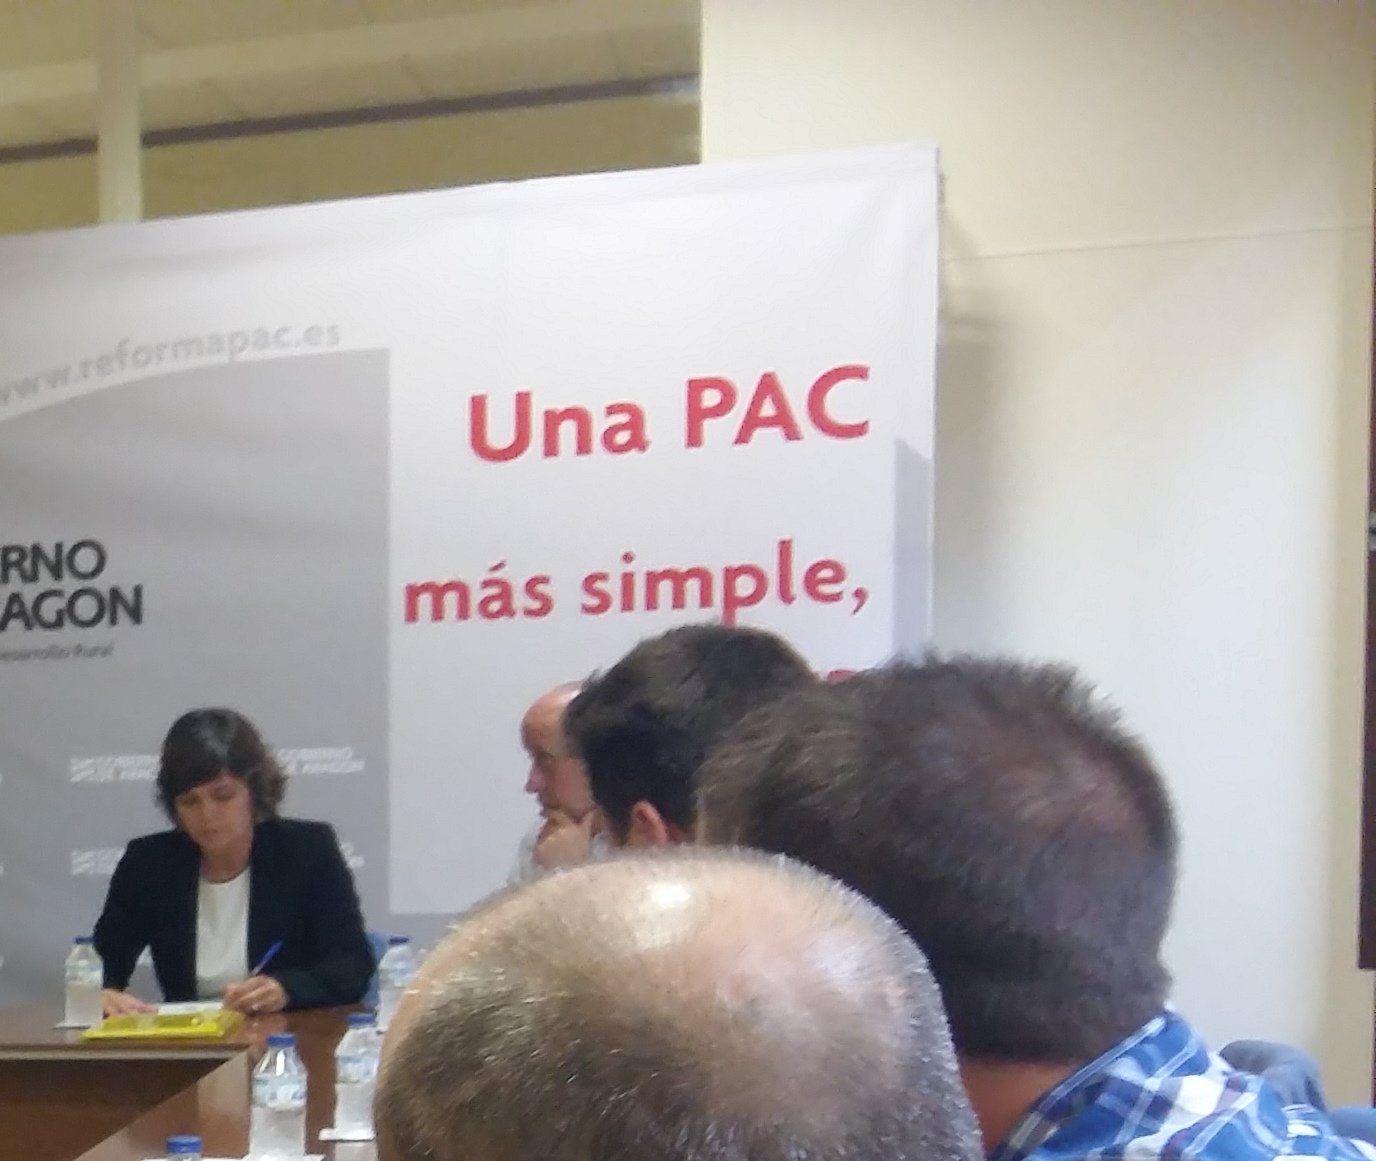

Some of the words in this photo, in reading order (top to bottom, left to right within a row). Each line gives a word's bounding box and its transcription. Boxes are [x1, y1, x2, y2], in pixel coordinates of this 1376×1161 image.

[469, 391, 651, 463] Una
[685, 364, 869, 448] PAC
[404, 560, 554, 624] más
[581, 538, 869, 628] simple,
[74, 641, 115, 658] Rural
